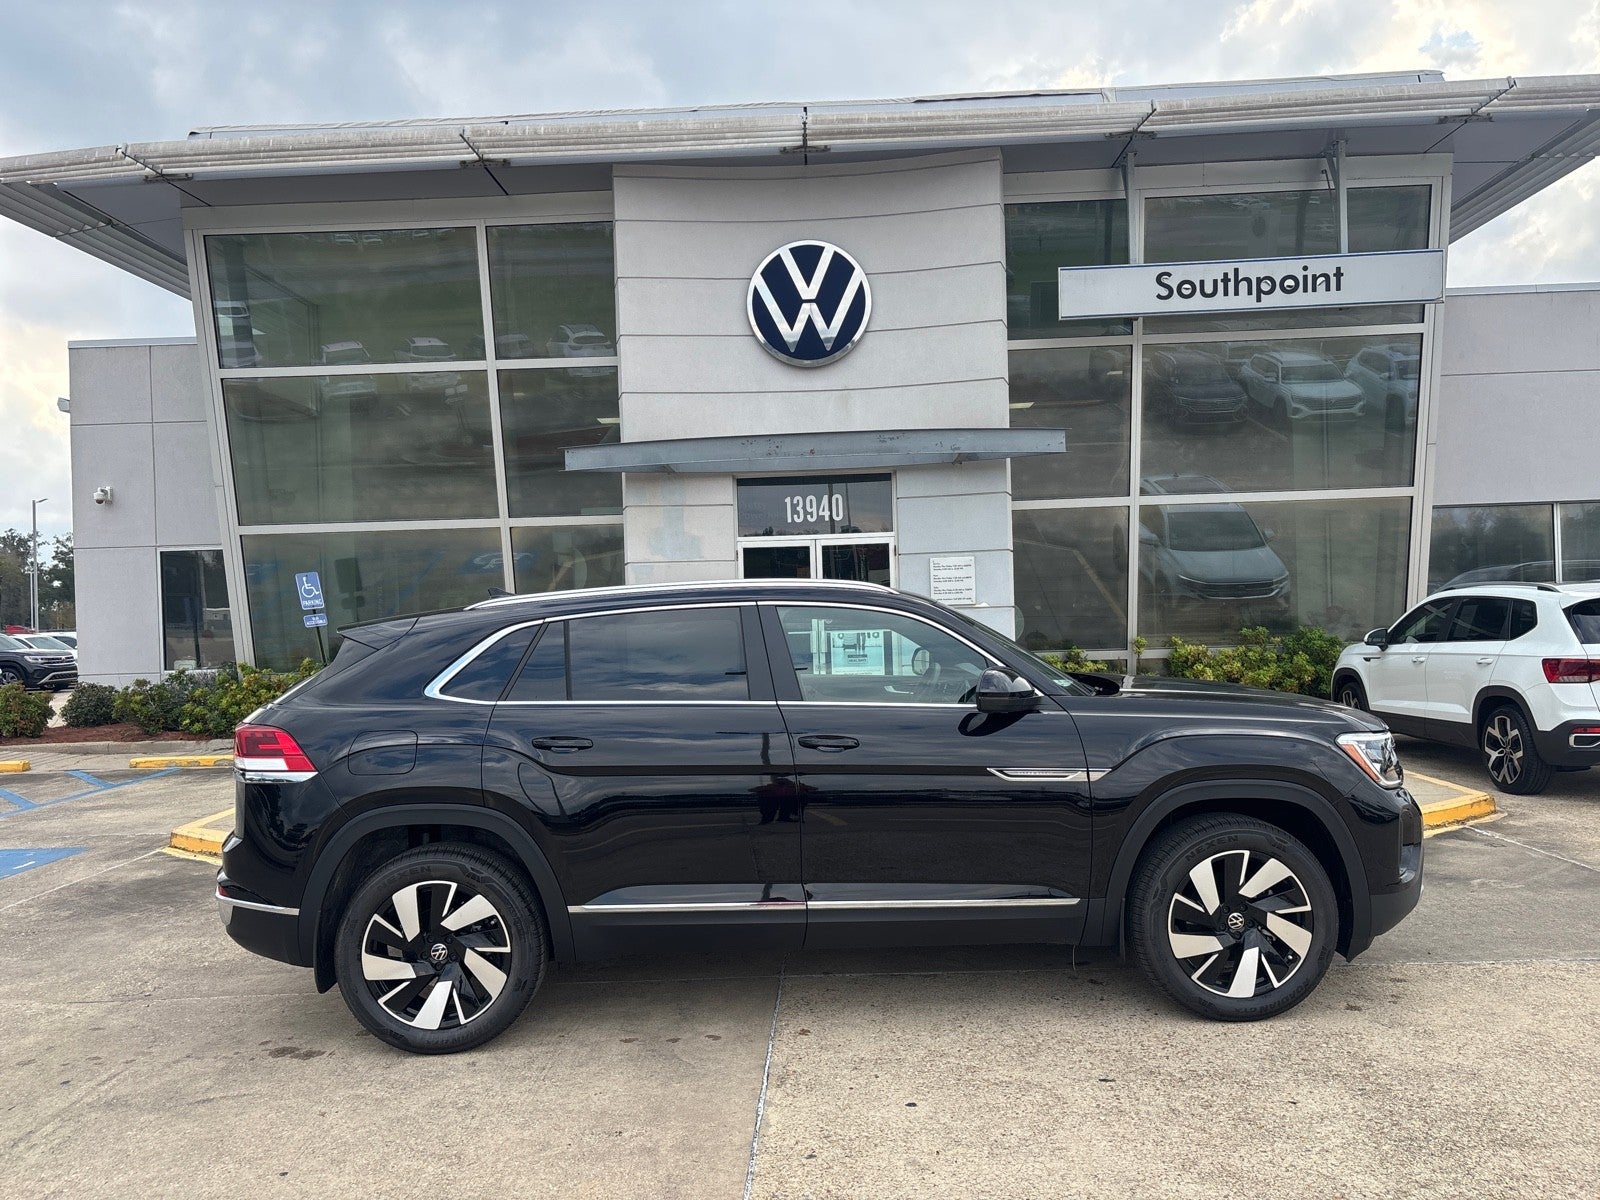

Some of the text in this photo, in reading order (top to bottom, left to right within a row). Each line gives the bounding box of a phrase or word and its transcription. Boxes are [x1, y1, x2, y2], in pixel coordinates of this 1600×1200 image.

[749, 242, 868, 354] VW
[1155, 265, 1344, 303] Southpoint
[784, 494, 844, 523] 13940
[1184, 834, 1239, 862] NEXEN
